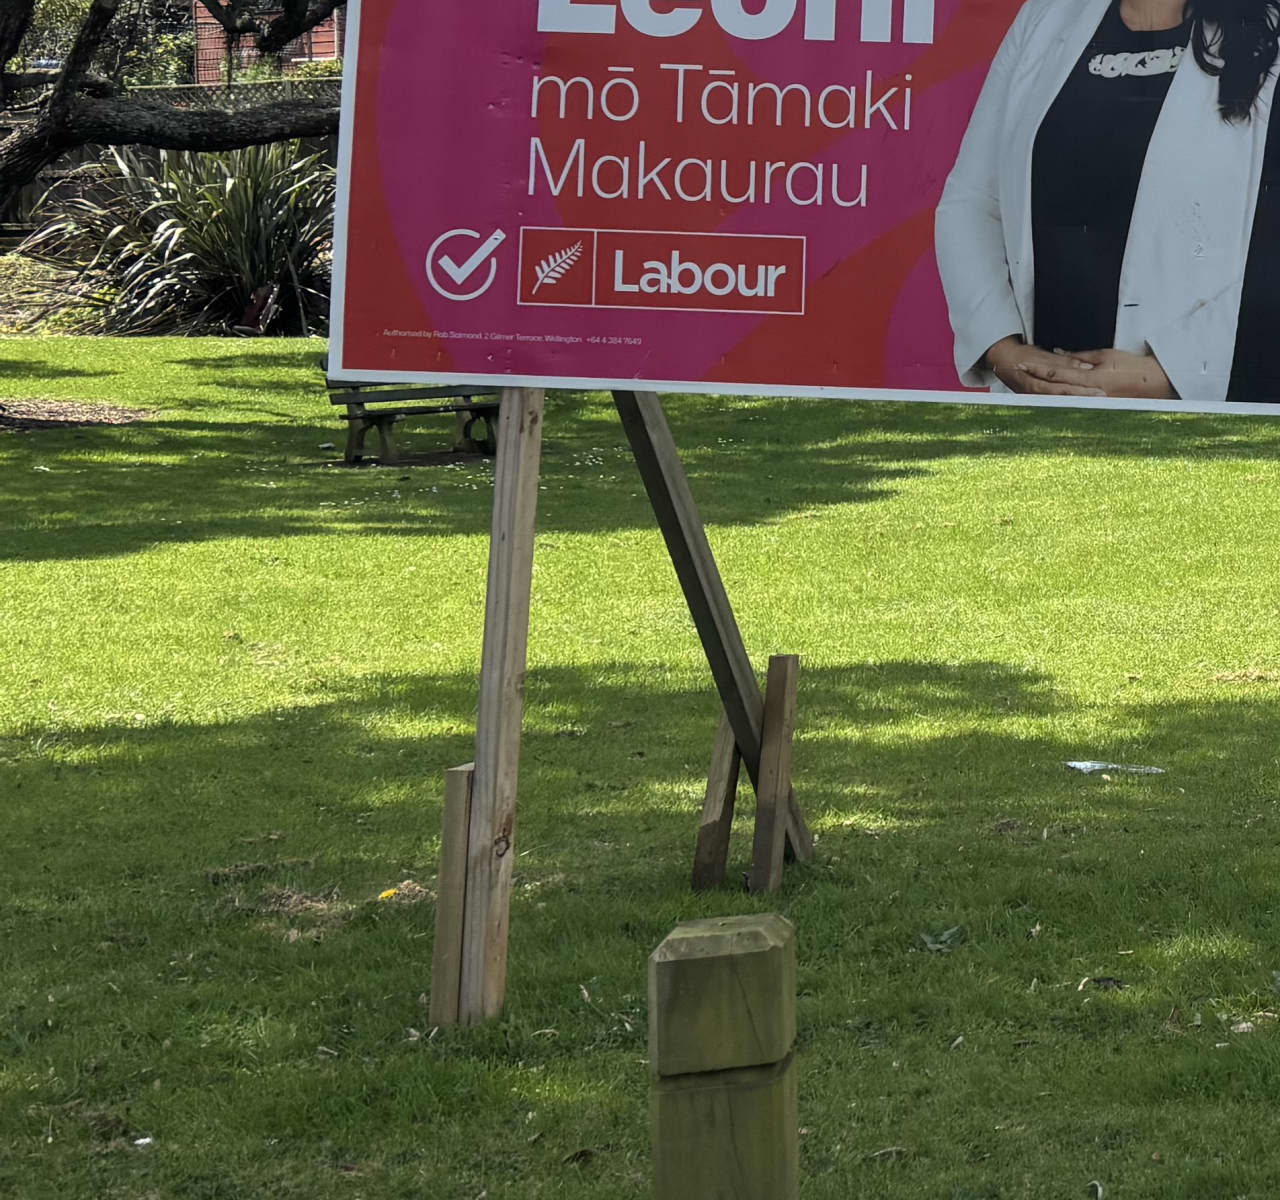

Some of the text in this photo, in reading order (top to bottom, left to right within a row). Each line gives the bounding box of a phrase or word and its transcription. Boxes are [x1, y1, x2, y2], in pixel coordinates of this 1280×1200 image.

[532, 64, 912, 130] mō Tāmaki
[528, 137, 867, 206] Makaurau
[614, 250, 786, 297] Labour
